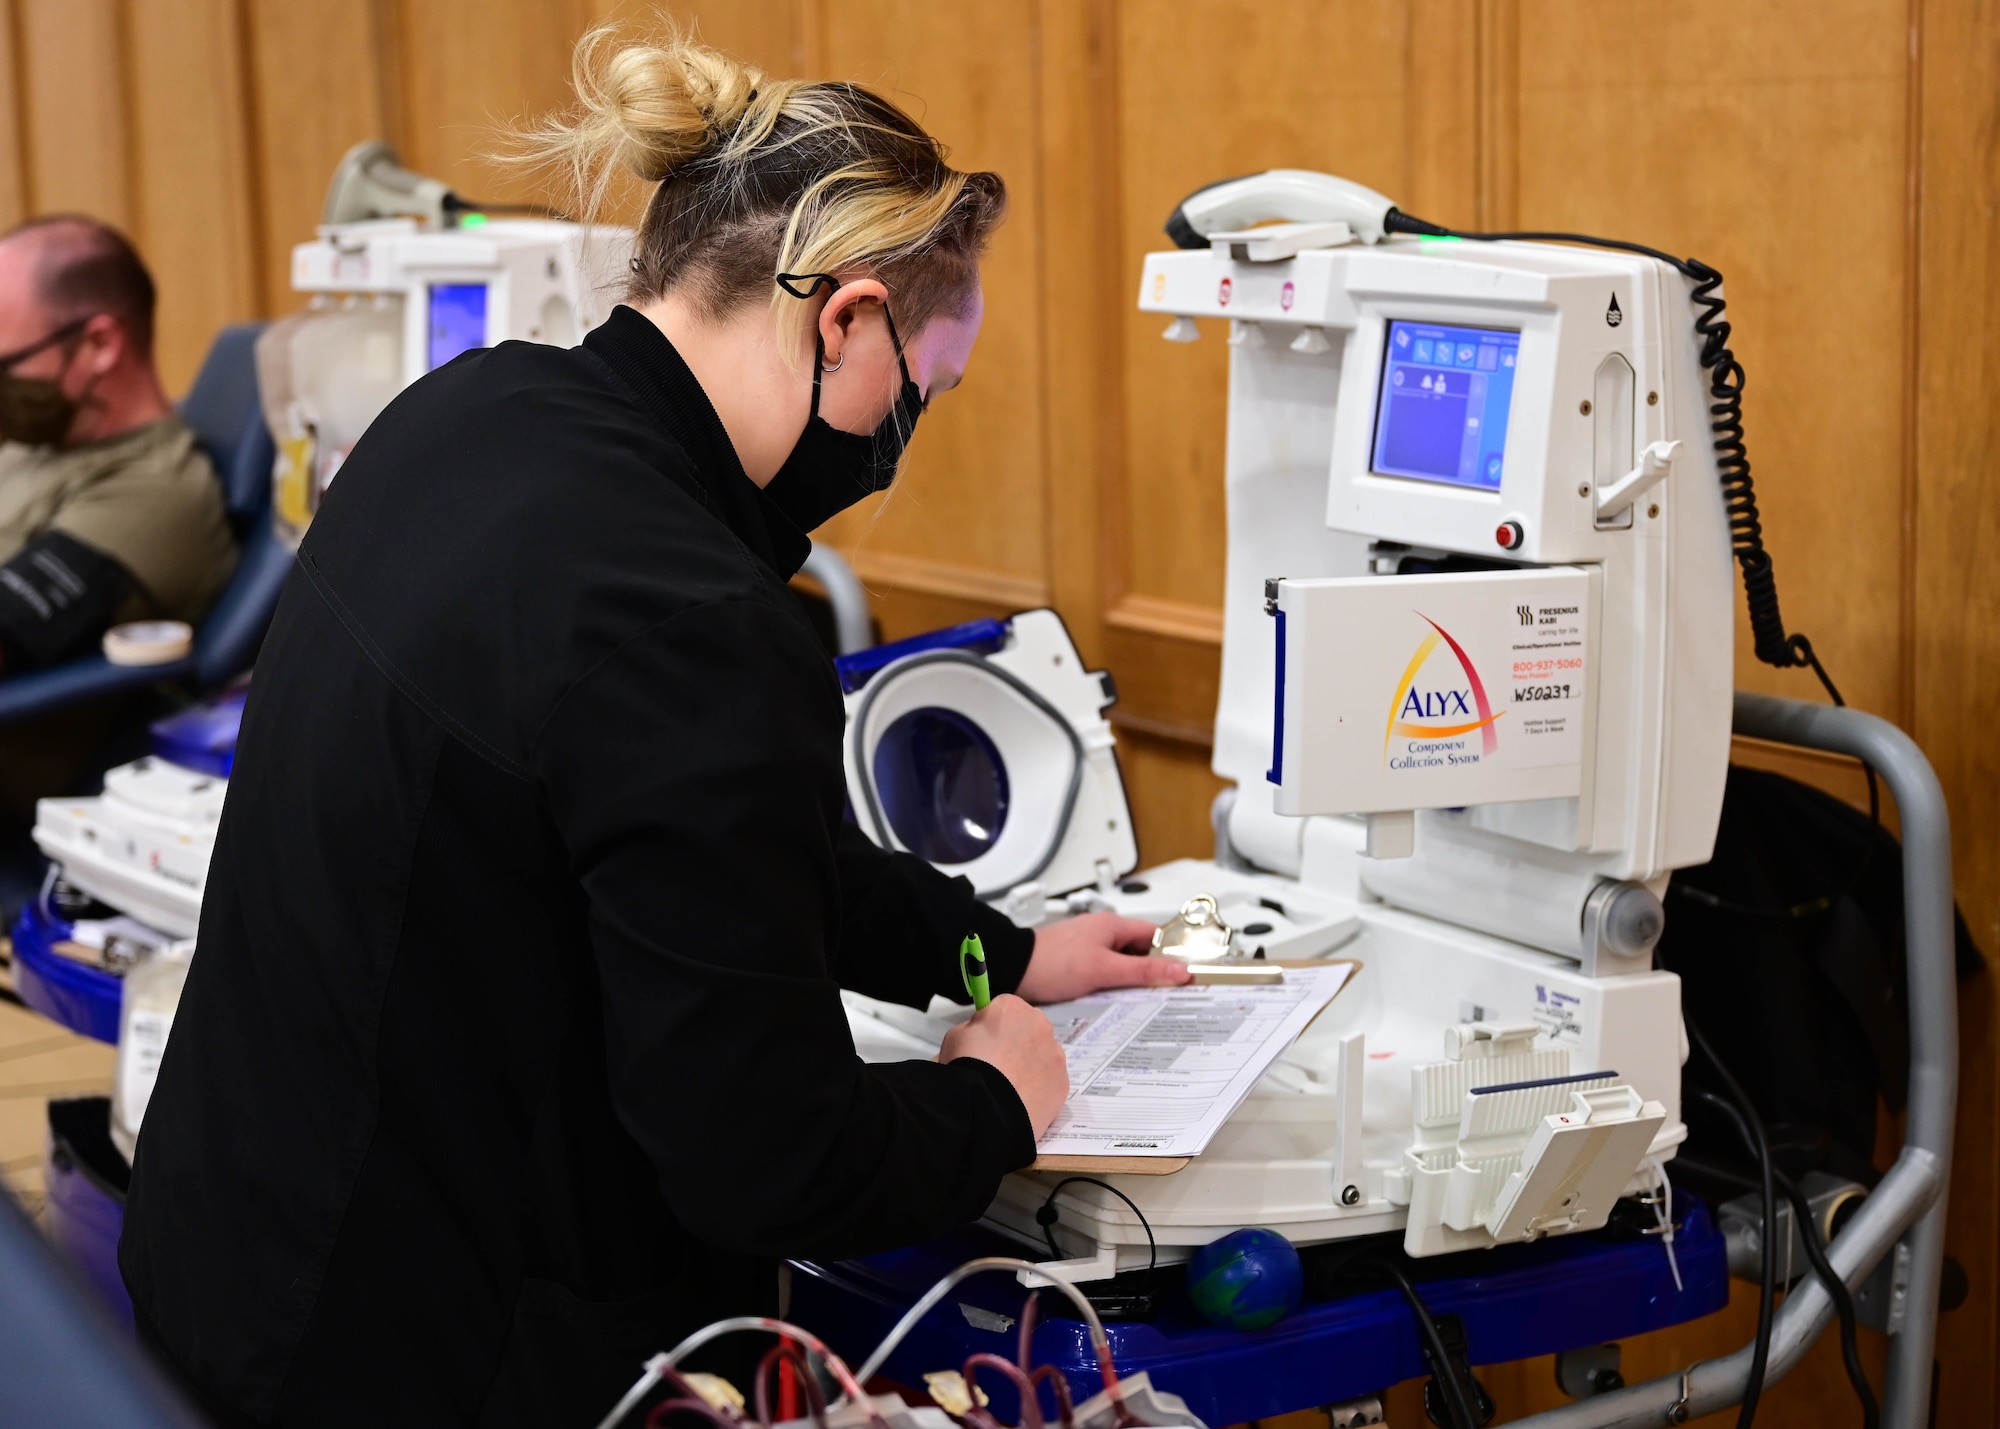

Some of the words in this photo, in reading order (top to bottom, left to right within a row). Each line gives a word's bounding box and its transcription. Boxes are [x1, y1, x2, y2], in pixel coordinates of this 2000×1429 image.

[1539, 606, 1579, 615] FRESENIUS
[1513, 658, 1583, 672] 800-937-5060
[1515, 684, 1570, 702] W50239
[1401, 686, 1470, 719] ALYX
